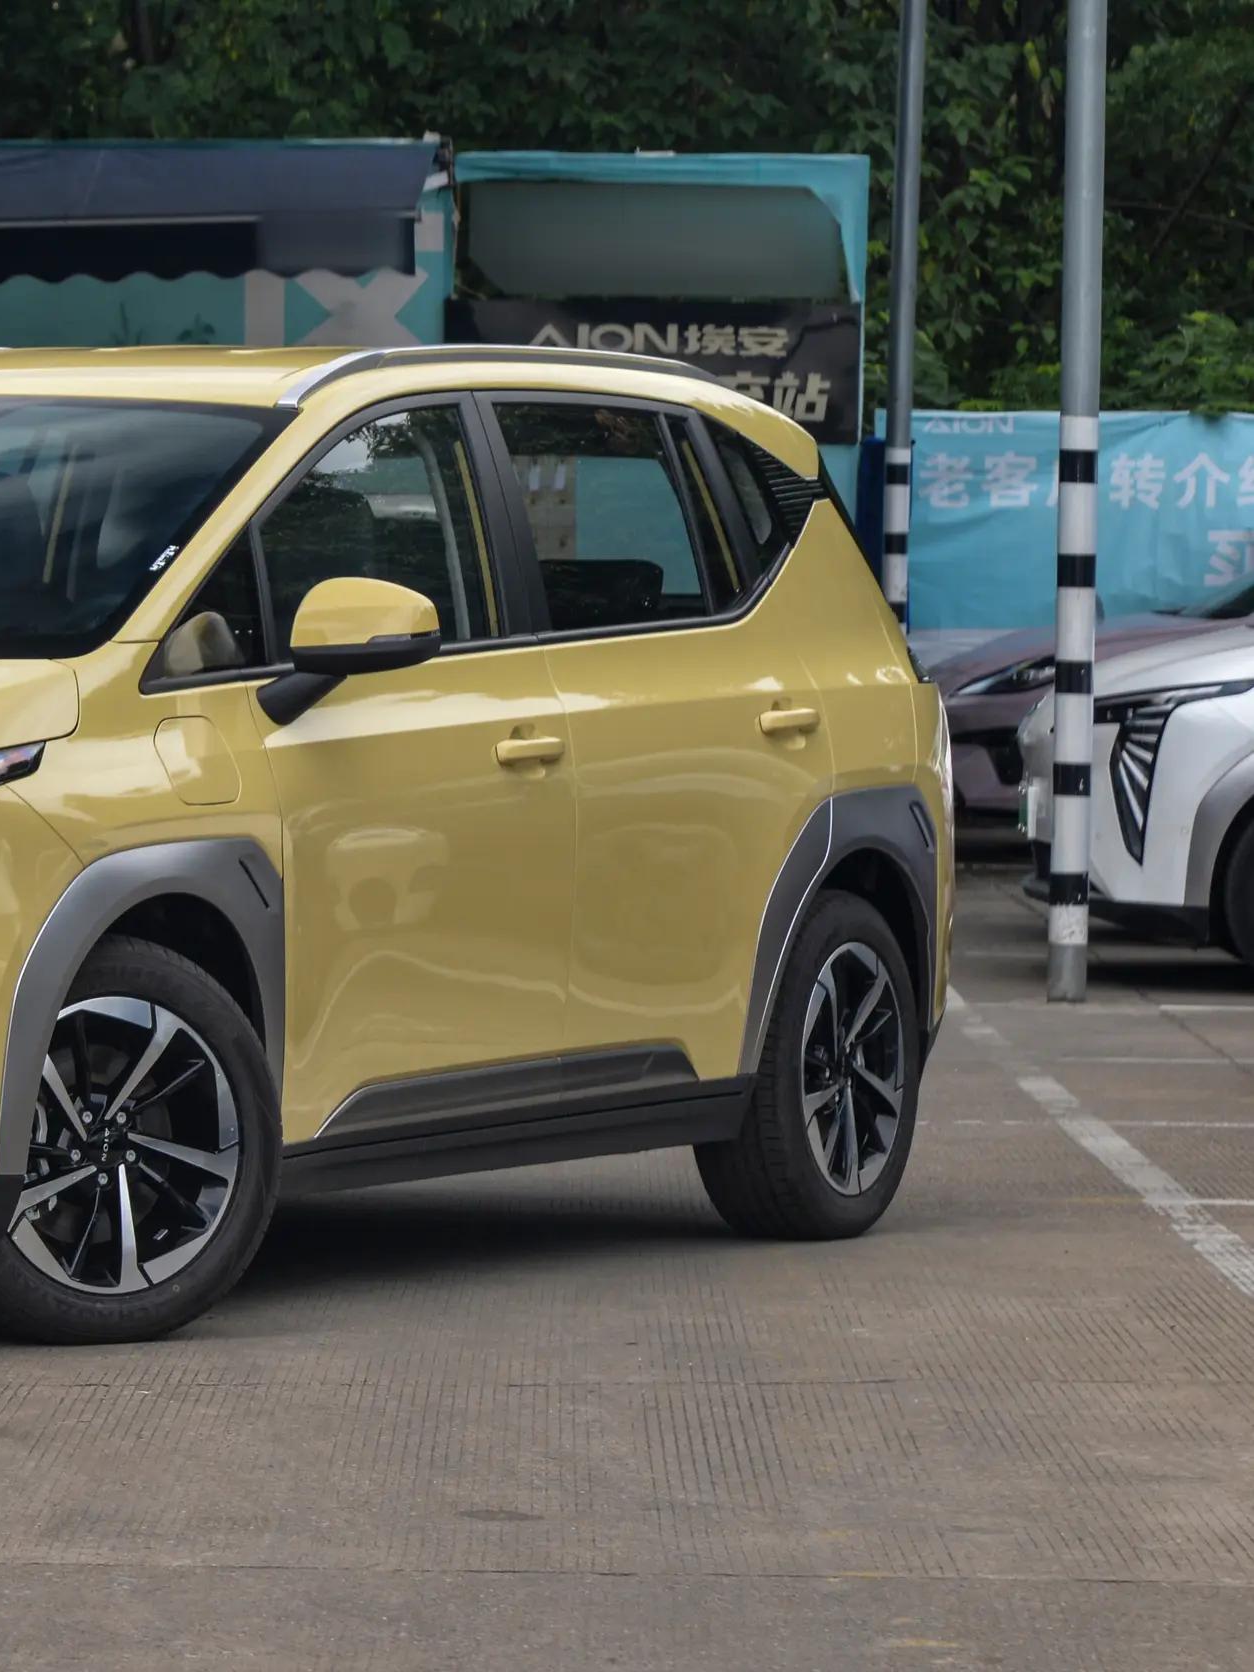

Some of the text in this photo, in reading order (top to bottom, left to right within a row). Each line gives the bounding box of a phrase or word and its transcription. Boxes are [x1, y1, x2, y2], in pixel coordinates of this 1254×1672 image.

[922, 415, 1014, 433] AION
[918, 451, 1254, 509] 老客转介
[101, 1127, 110, 1162] AION
